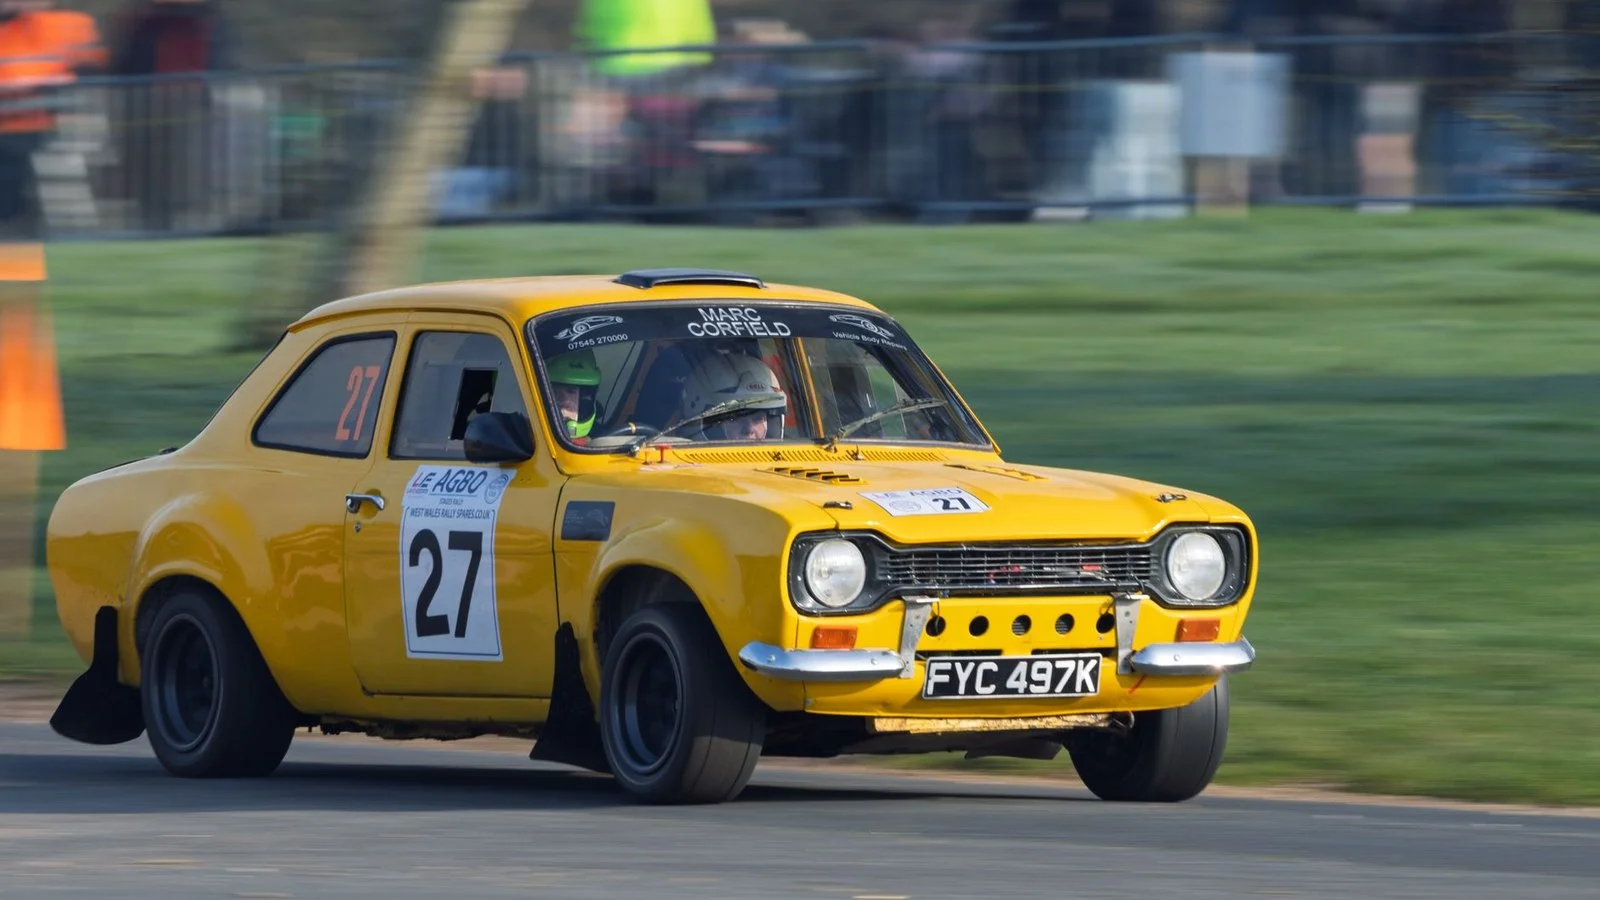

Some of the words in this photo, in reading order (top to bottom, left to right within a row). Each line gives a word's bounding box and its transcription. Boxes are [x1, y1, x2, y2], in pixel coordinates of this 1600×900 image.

[697, 306, 762, 321] MARC
[687, 321, 791, 337] CORFIELD
[568, 339, 596, 350] 07545
[597, 333, 628, 344] 270000
[832, 331, 860, 341] Vehicle
[860, 335, 880, 344] Body
[335, 366, 381, 441] 27
[412, 471, 437, 488] LE
[431, 469, 488, 494] AGBO
[932, 497, 971, 511] 27
[410, 507, 424, 518] WEST
[424, 508, 440, 518] WALES
[441, 508, 456, 518] RALLY
[408, 528, 483, 638] 27
[926, 661, 999, 695] FYC
[1005, 658, 1099, 694] 497K
